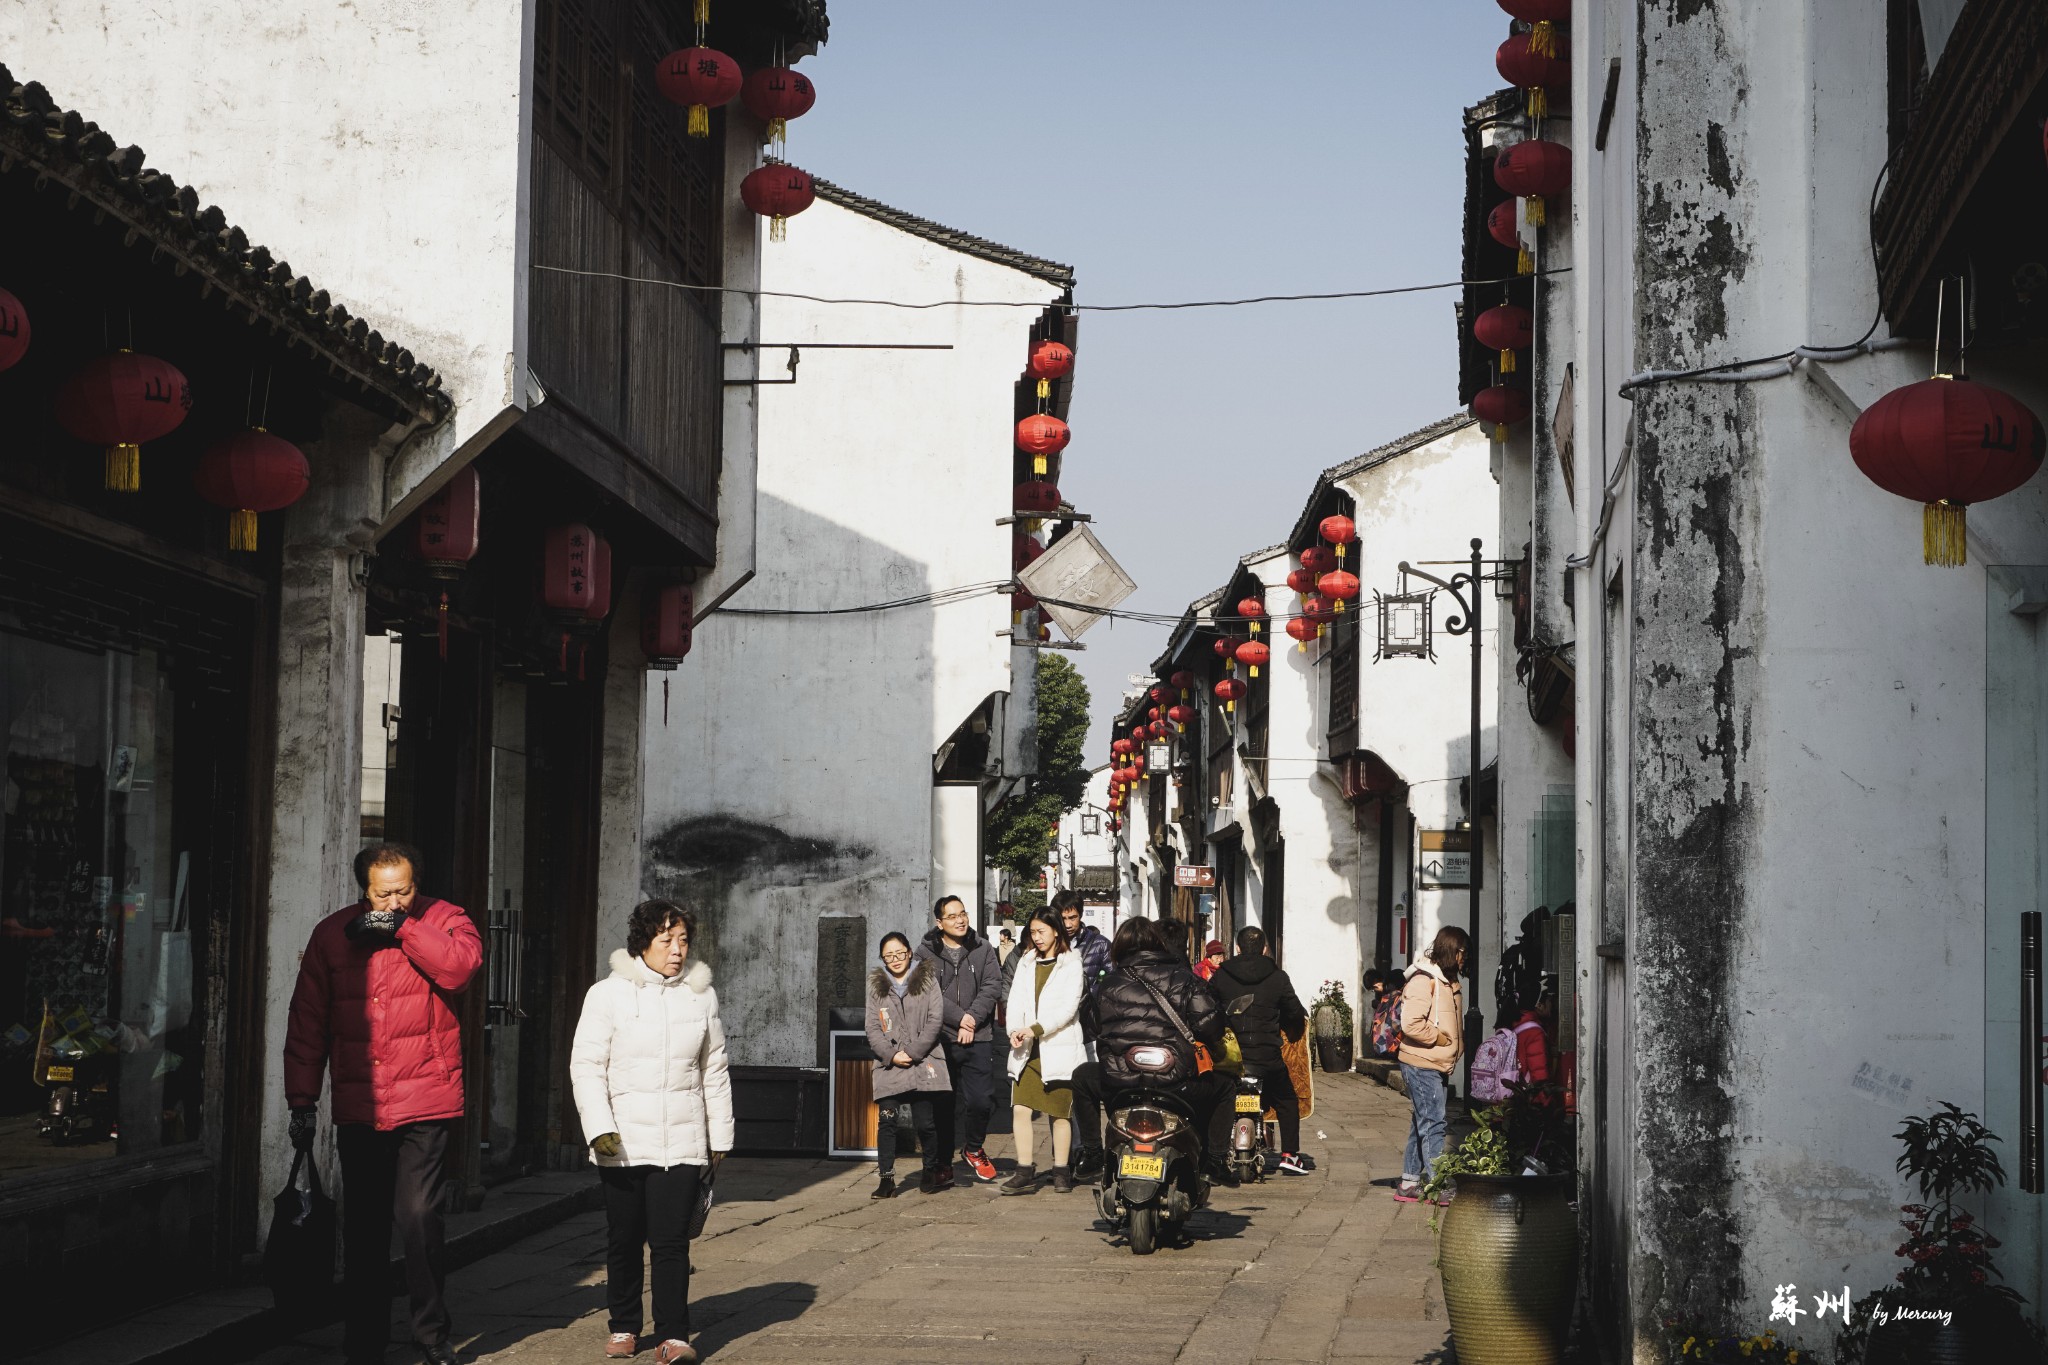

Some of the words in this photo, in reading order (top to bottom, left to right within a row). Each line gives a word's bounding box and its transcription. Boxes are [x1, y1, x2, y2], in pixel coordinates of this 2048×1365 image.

[670, 59, 719, 77] 山塘
[769, 76, 809, 95] 山塘
[570, 534, 587, 595] 苏州故事
[681, 594, 691, 645] 苏州故事
[1447, 857, 1470, 867] 游船码
[1124, 1162, 1159, 1173] 3141784
